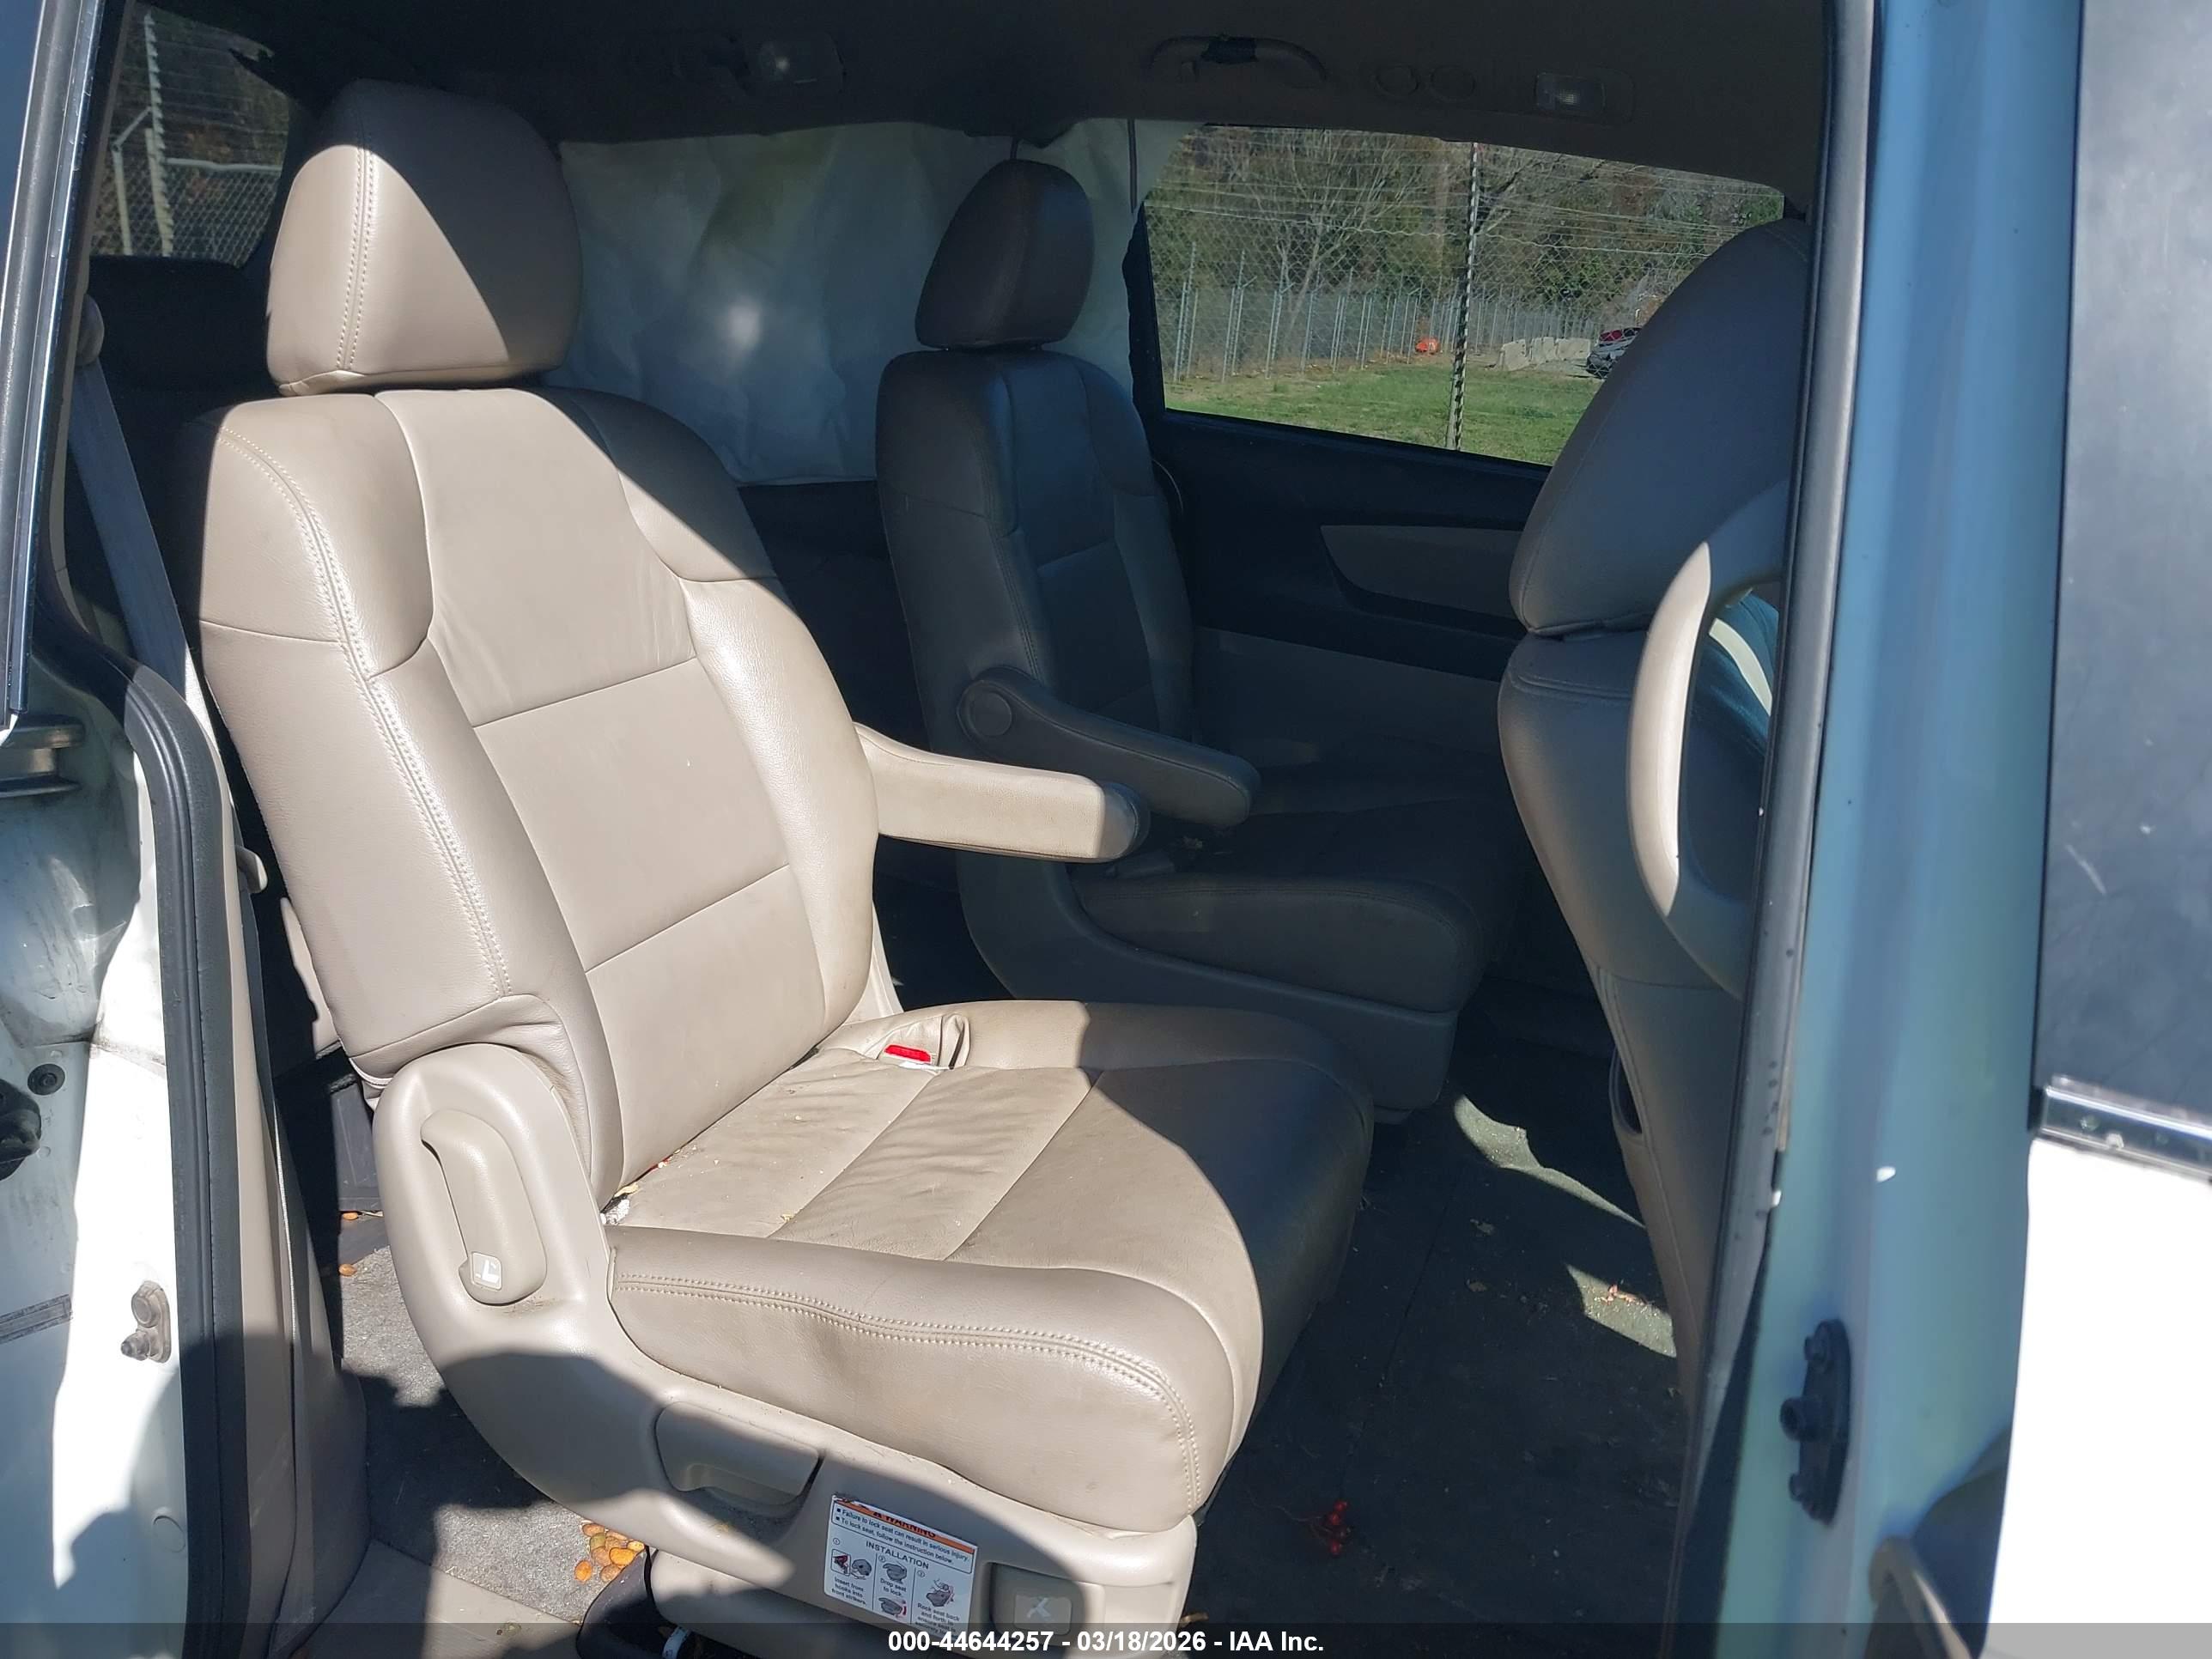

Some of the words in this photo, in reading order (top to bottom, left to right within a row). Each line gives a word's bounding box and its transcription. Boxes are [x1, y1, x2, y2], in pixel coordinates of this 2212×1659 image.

[842, 1509, 860, 1521] Failure
[869, 1519, 880, 1528] lock
[881, 1525, 893, 1534] seat
[905, 1534, 921, 1544] result
[929, 1543, 950, 1554] serious
[876, 1530, 893, 1542] follow
[904, 1542, 933, 1557] instruction
[866, 1540, 929, 1570] INSTALLATION
[880, 1577, 893, 1588] Drop
[917, 1602, 932, 1612] Rock
